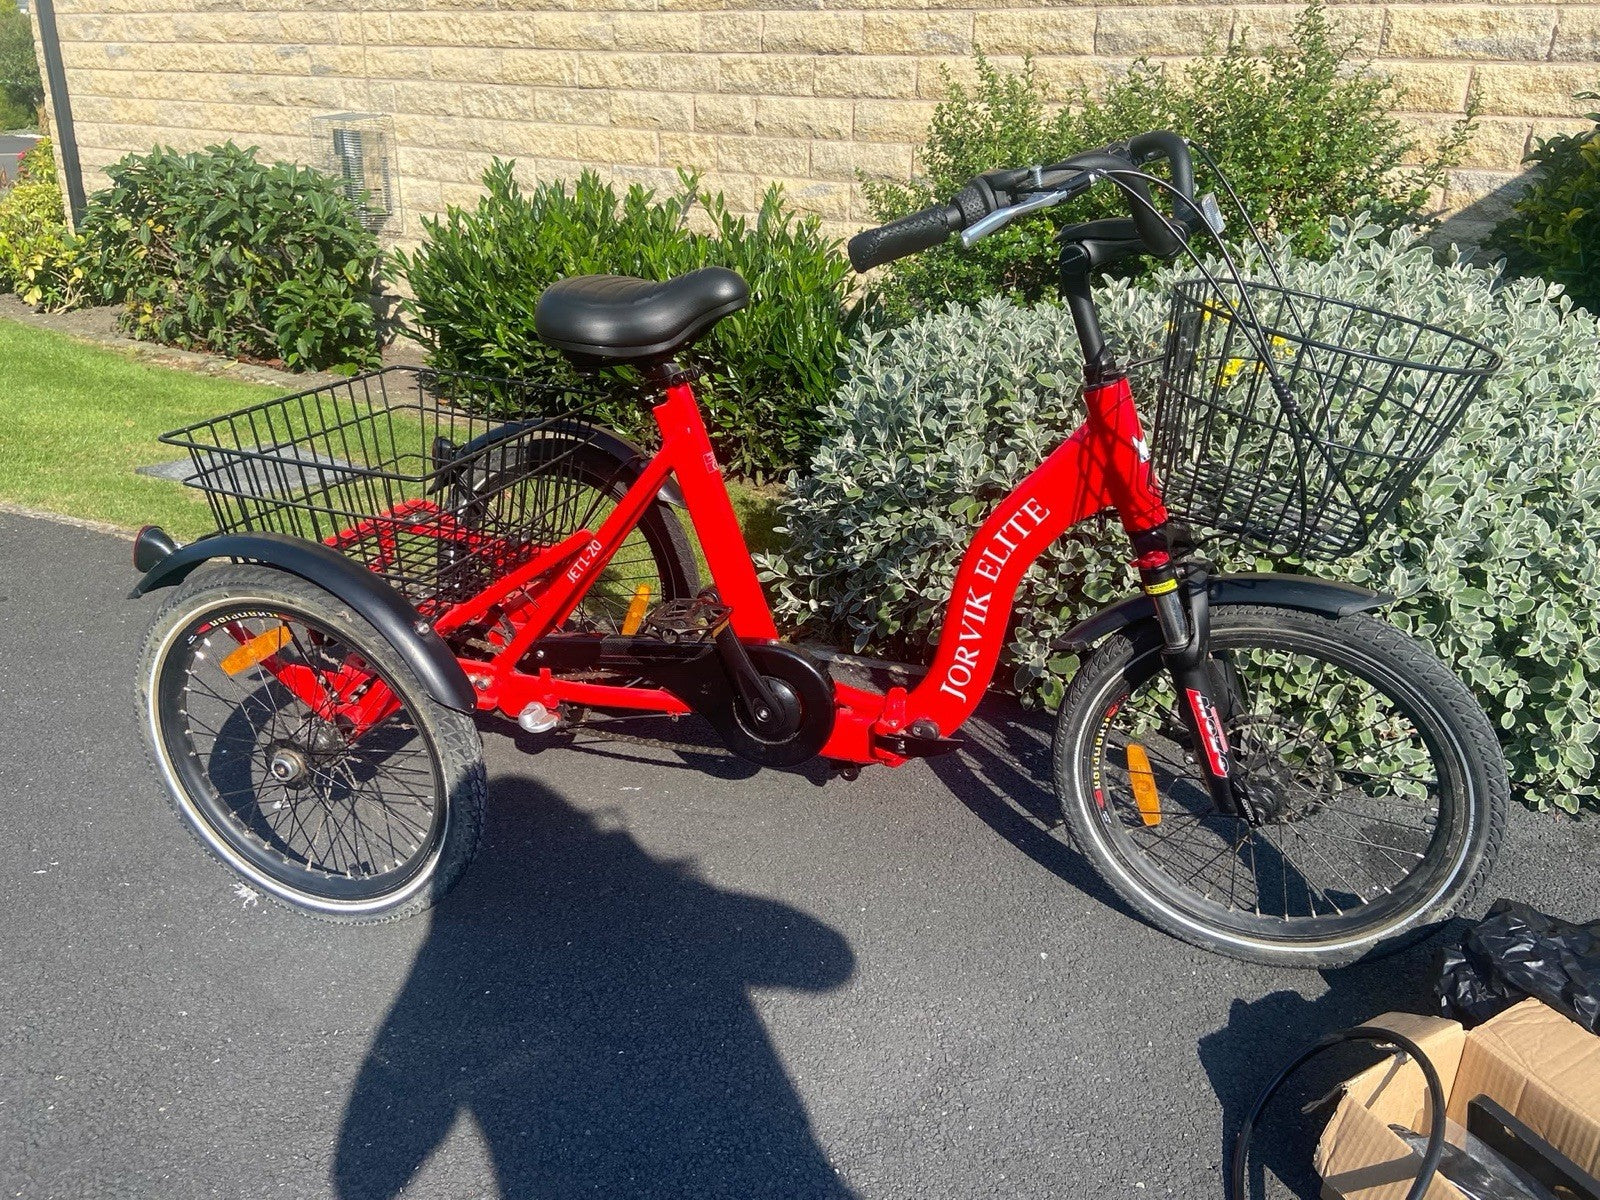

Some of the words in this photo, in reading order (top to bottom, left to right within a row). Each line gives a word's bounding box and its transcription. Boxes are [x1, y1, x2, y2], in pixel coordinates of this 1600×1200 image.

[567, 540, 602, 584] JET1-20
[940, 586, 992, 703] JORVIK
[974, 497, 1050, 584] ELITE
